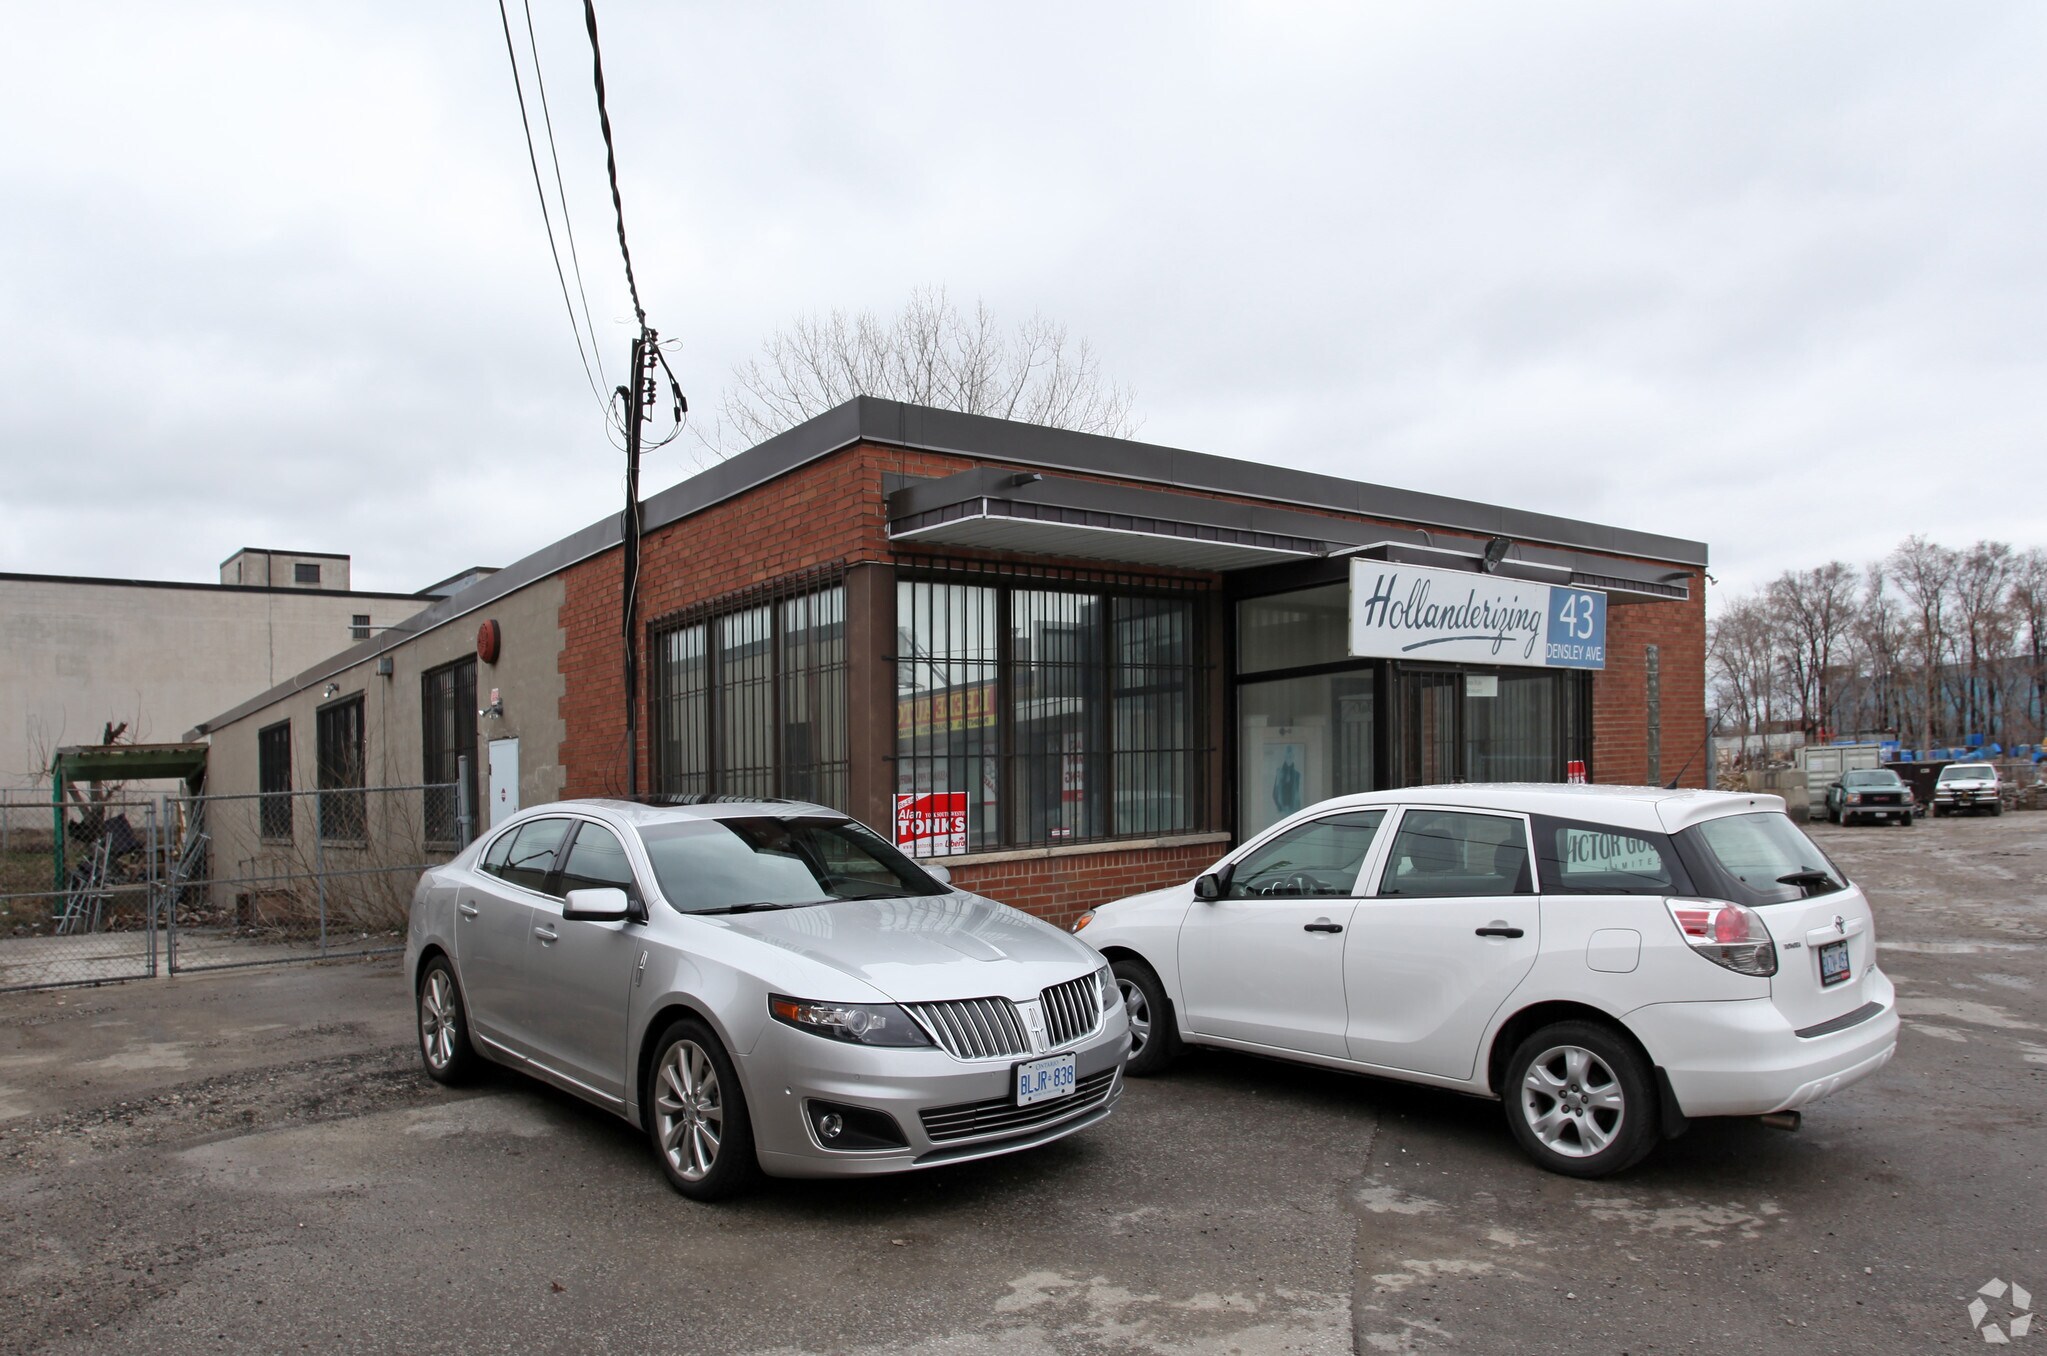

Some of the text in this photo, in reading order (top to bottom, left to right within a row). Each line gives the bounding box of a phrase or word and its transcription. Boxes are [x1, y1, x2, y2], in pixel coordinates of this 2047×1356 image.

[1365, 573, 1543, 659] Hollanderizing
[1560, 594, 1594, 639] 43
[1546, 643, 1584, 660] DENSLEY
[898, 809, 922, 820] Alan
[898, 817, 966, 836] TONKS
[1021, 1065, 1074, 1095] BLJR 838
